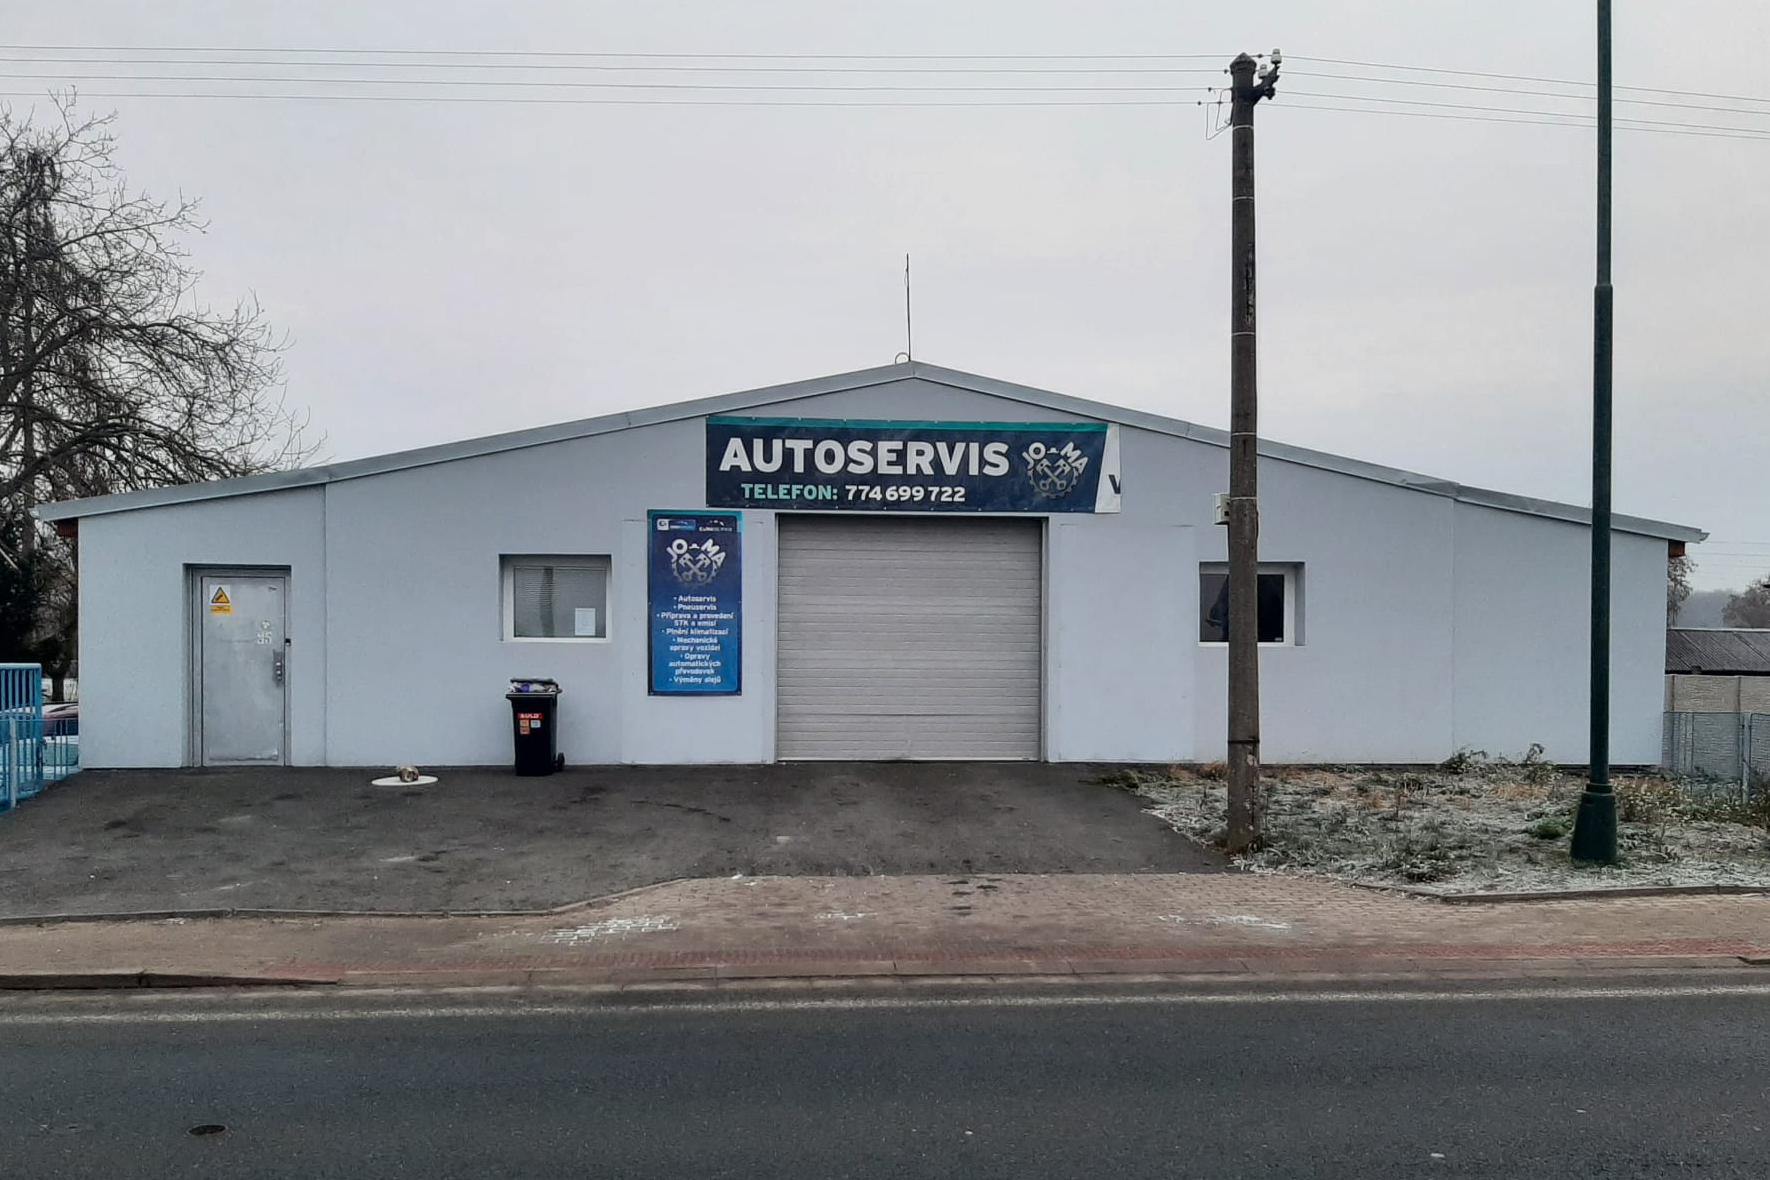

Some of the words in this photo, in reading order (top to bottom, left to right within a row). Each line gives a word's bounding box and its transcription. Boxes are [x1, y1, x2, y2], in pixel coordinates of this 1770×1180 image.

[719, 437, 1010, 476] AUTOSERVIS
[741, 483, 838, 500] TELEFON:
[845, 485, 882, 501] 774
[885, 486, 924, 501] 699
[928, 486, 965, 502] 722
[677, 603, 717, 611] Pneuservis
